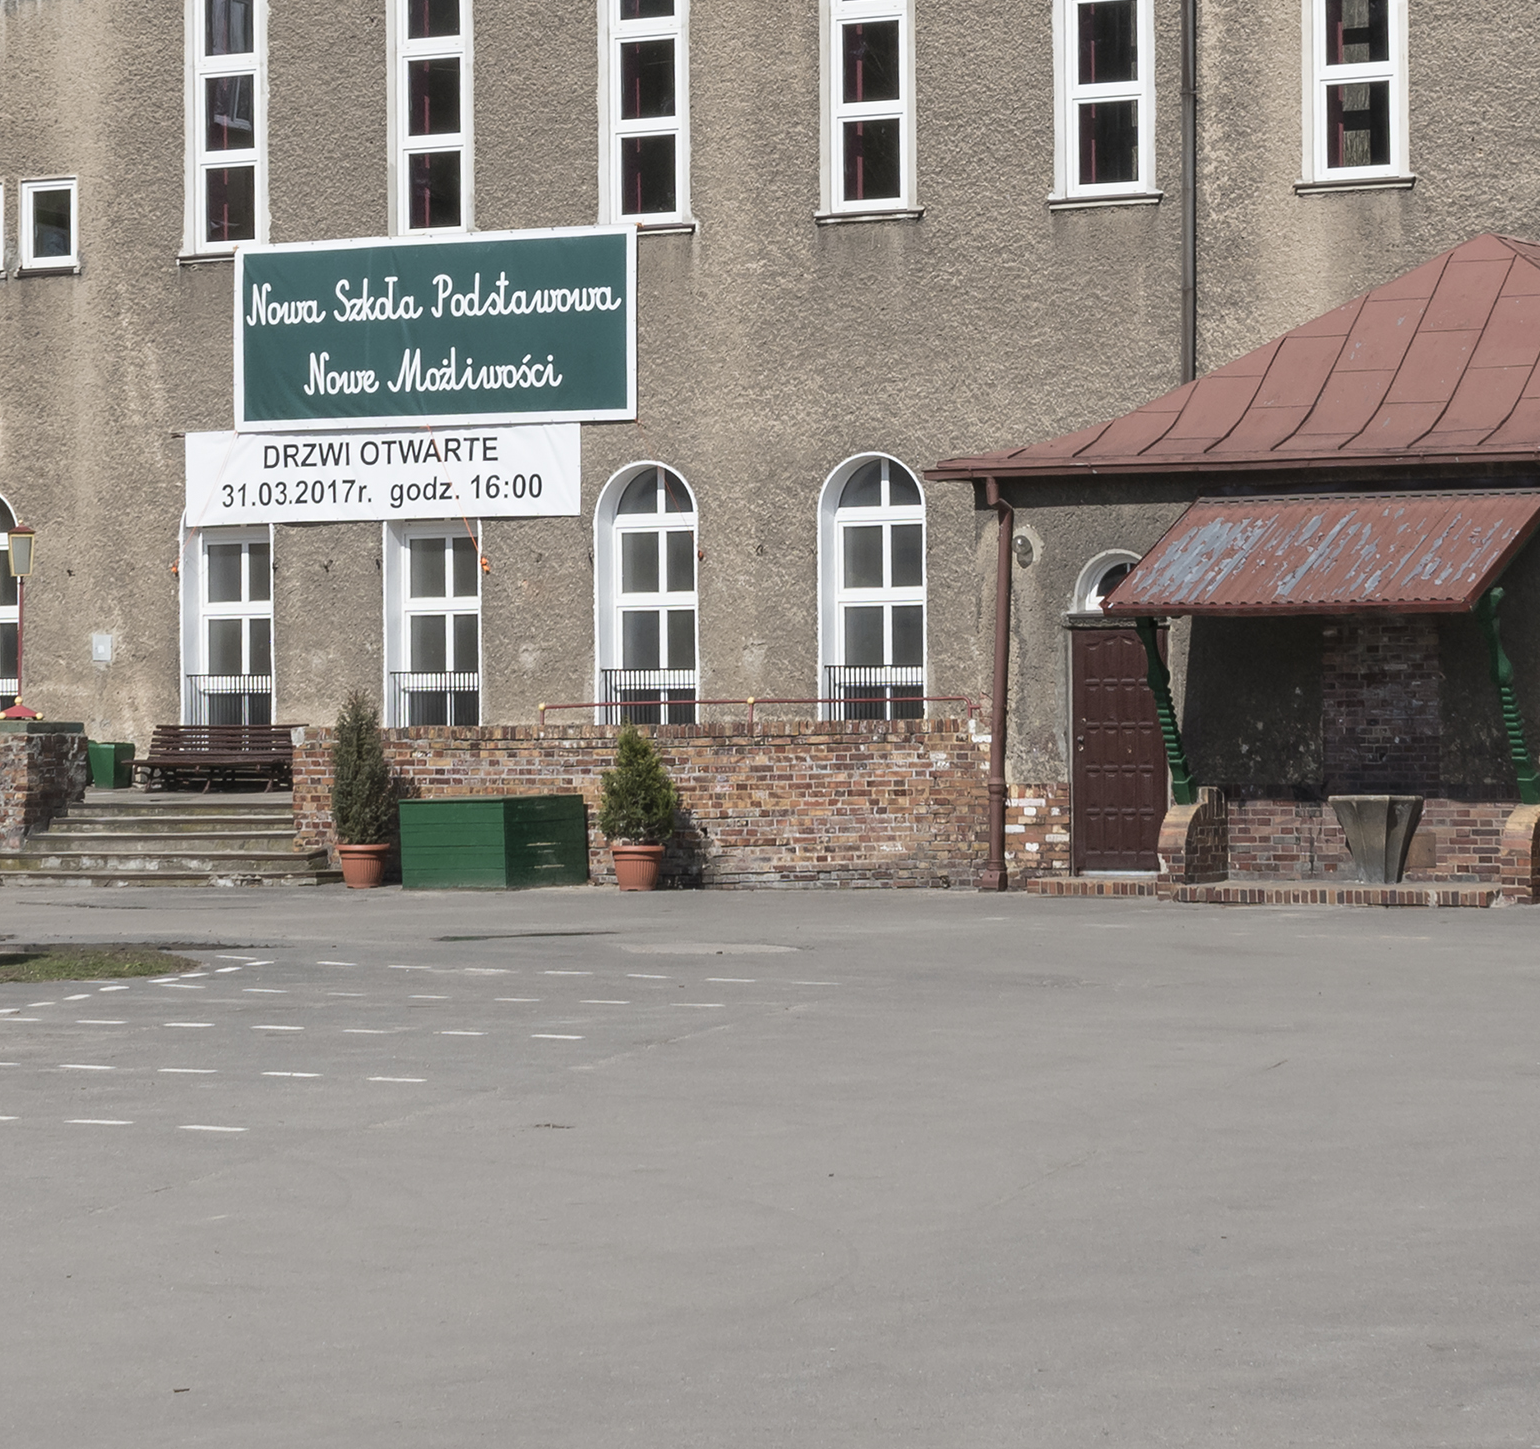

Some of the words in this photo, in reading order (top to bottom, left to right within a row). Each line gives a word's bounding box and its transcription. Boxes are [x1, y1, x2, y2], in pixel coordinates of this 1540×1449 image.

[247, 283, 326, 326] Nowa
[334, 277, 423, 322] Szkoła
[431, 272, 621, 317] Podstawowa
[304, 352, 379, 395] Nowe
[388, 347, 562, 392] Możliwości
[264, 443, 350, 469] DRZWI
[360, 437, 499, 466] OTWARTE
[222, 479, 372, 508] 31.03.2017r.
[390, 476, 460, 509] godz.
[471, 473, 543, 499] 16:00
